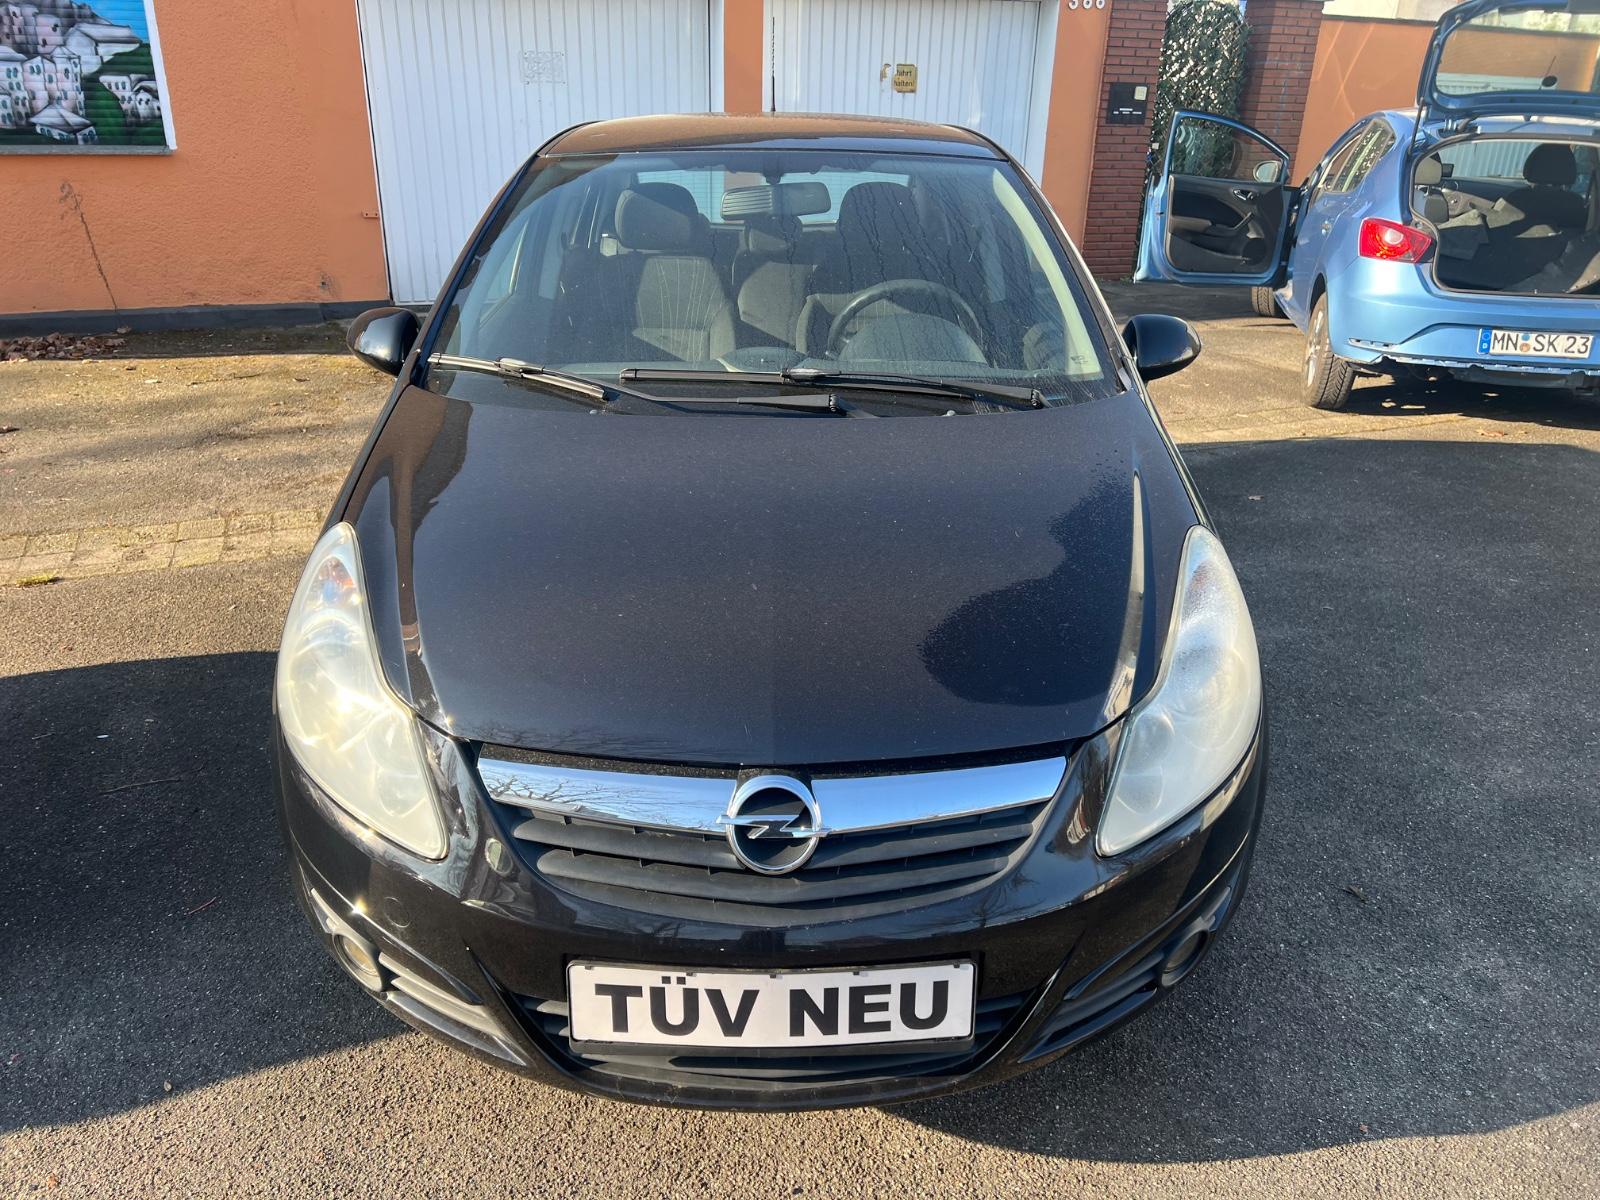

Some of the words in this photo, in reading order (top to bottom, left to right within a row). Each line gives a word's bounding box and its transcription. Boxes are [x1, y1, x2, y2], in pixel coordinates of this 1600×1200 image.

[1492, 333, 1519, 351] MN
[1533, 334, 1560, 353] SK
[1564, 336, 1590, 354] 23
[594, 976, 760, 1037] TÜV
[789, 980, 949, 1037] NEU
